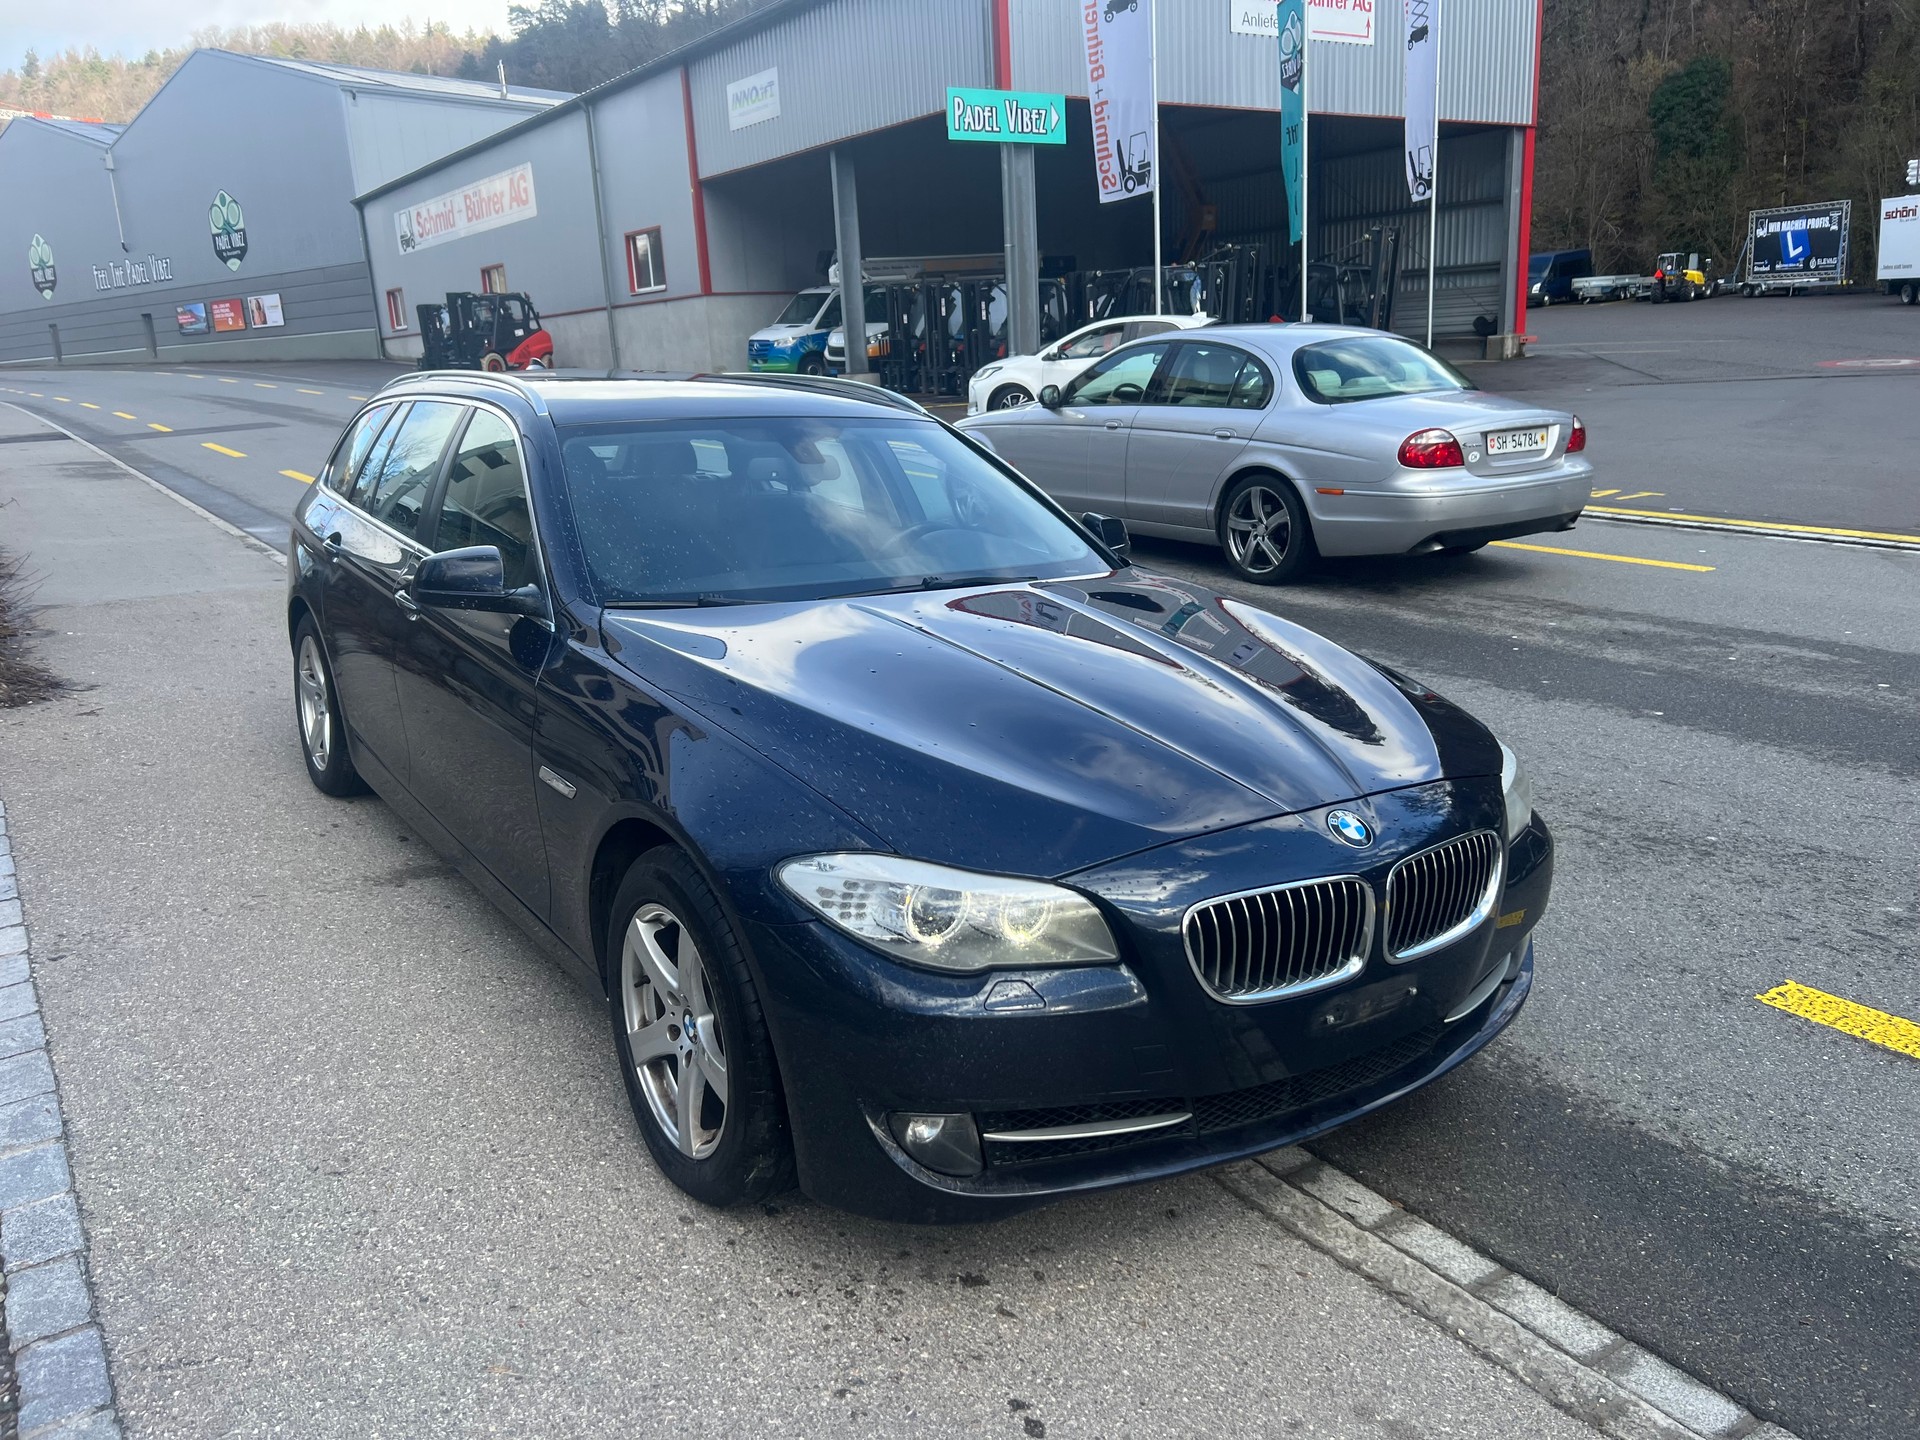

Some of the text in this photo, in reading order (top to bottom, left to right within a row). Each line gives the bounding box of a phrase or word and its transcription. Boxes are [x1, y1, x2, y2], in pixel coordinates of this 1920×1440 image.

[1242, 11, 1278, 29] Anliefe
[953, 96, 1048, 135] PADEL VIBEZ
[416, 199, 456, 239] Schmid
[464, 189, 505, 224] Bührer
[509, 173, 529, 210] AG
[1768, 221, 1781, 232] WIR
[1781, 219, 1807, 232] MACHEN
[1496, 435, 1507, 450] SH
[1511, 433, 1538, 449] 54784
